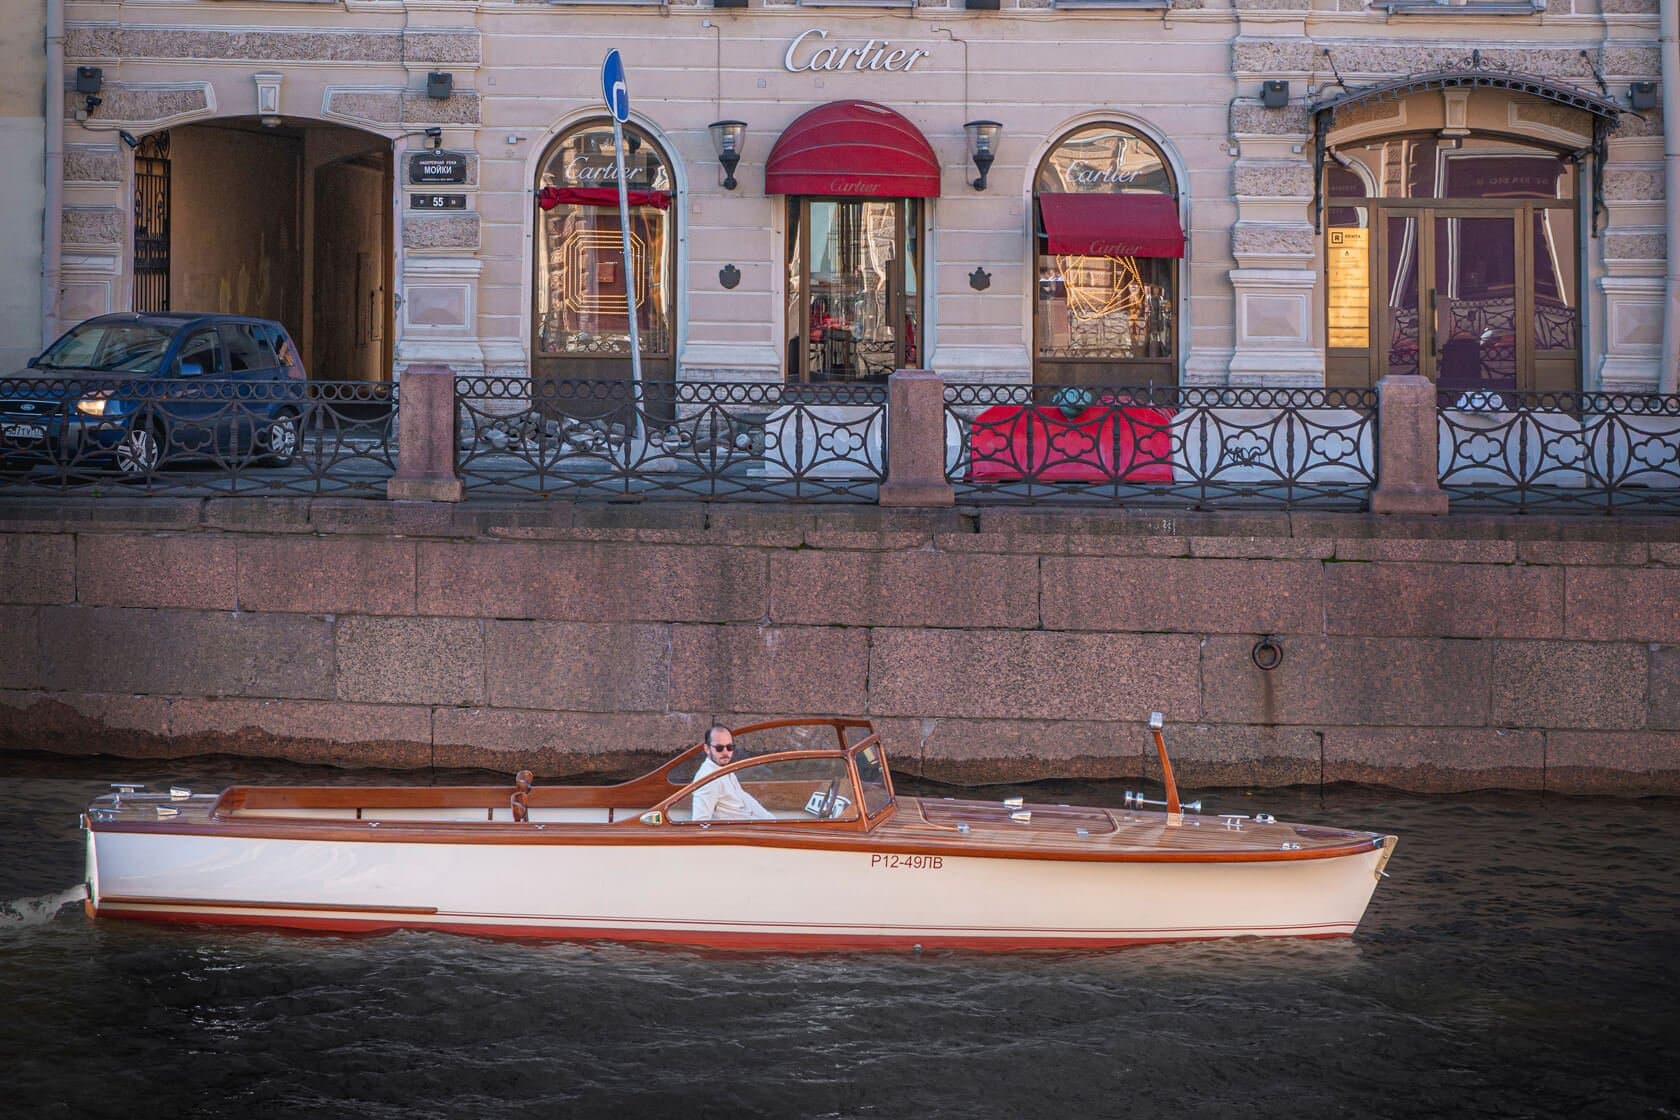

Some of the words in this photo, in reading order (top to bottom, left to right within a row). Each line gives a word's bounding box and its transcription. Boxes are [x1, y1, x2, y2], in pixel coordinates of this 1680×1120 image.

[785, 28, 930, 72] Cartier
[424, 165, 452, 175] МОЙКИ
[1065, 159, 1143, 183] Cartier
[830, 177, 881, 193] Cartier
[432, 196, 444, 207] 55
[1089, 239, 1143, 255] Cartier
